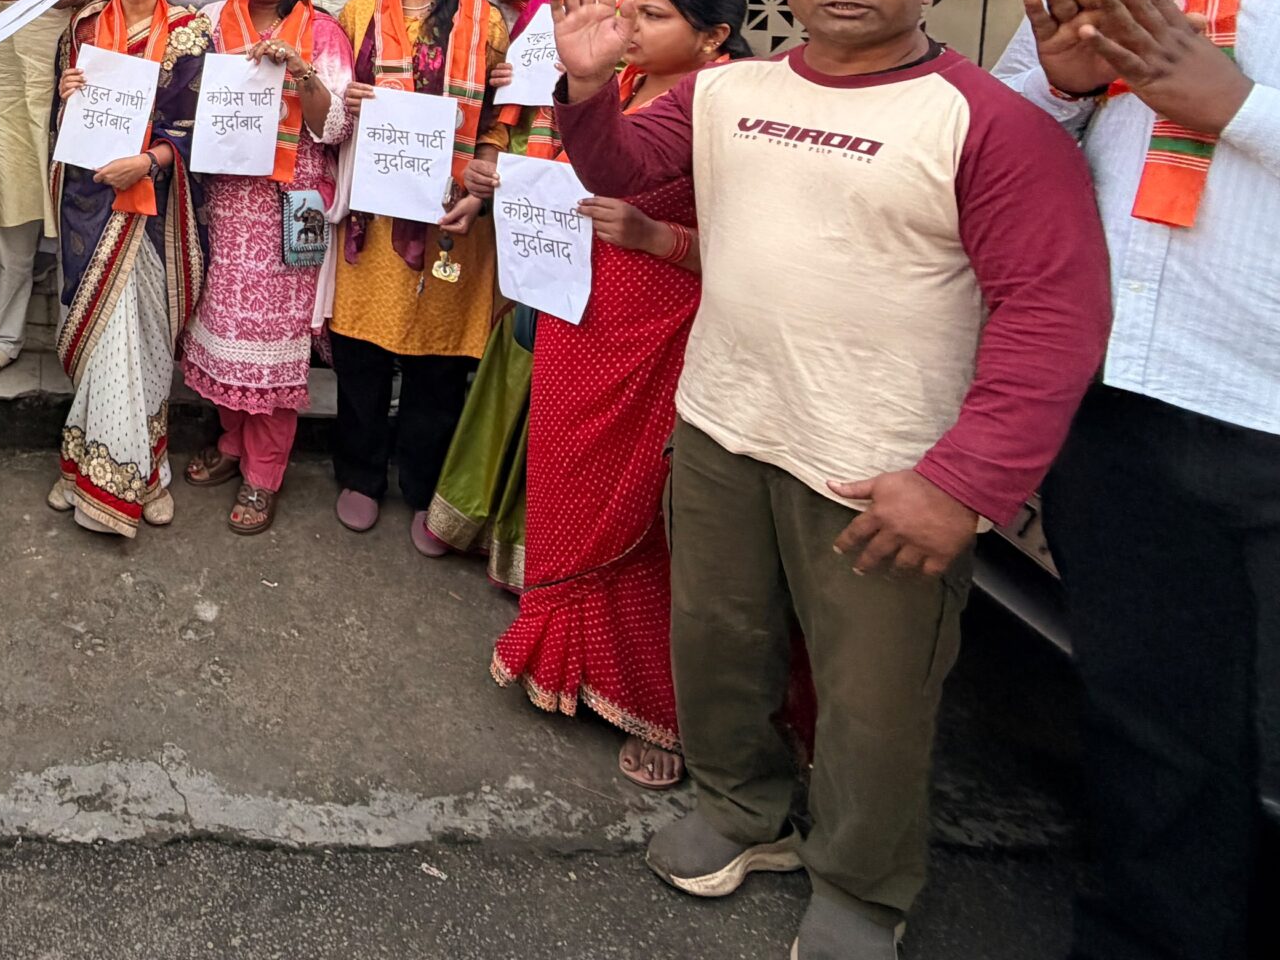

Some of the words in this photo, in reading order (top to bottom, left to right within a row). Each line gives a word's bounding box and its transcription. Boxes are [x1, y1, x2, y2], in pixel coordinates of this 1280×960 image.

[115, 90, 146, 110] गांधी
[206, 86, 244, 107] कांग्रेस
[249, 87, 275, 107] पार्टी
[83, 108, 132, 134] मुर्दाबाद
[211, 110, 263, 136] मुर्दाबाद
[366, 122, 410, 146] कांग्रेस
[415, 130, 447, 150] पार्टी
[373, 151, 433, 178] मुर्दाबाद
[501, 197, 546, 225] कांग्रेस
[511, 230, 572, 265] मुर्दाबाद
